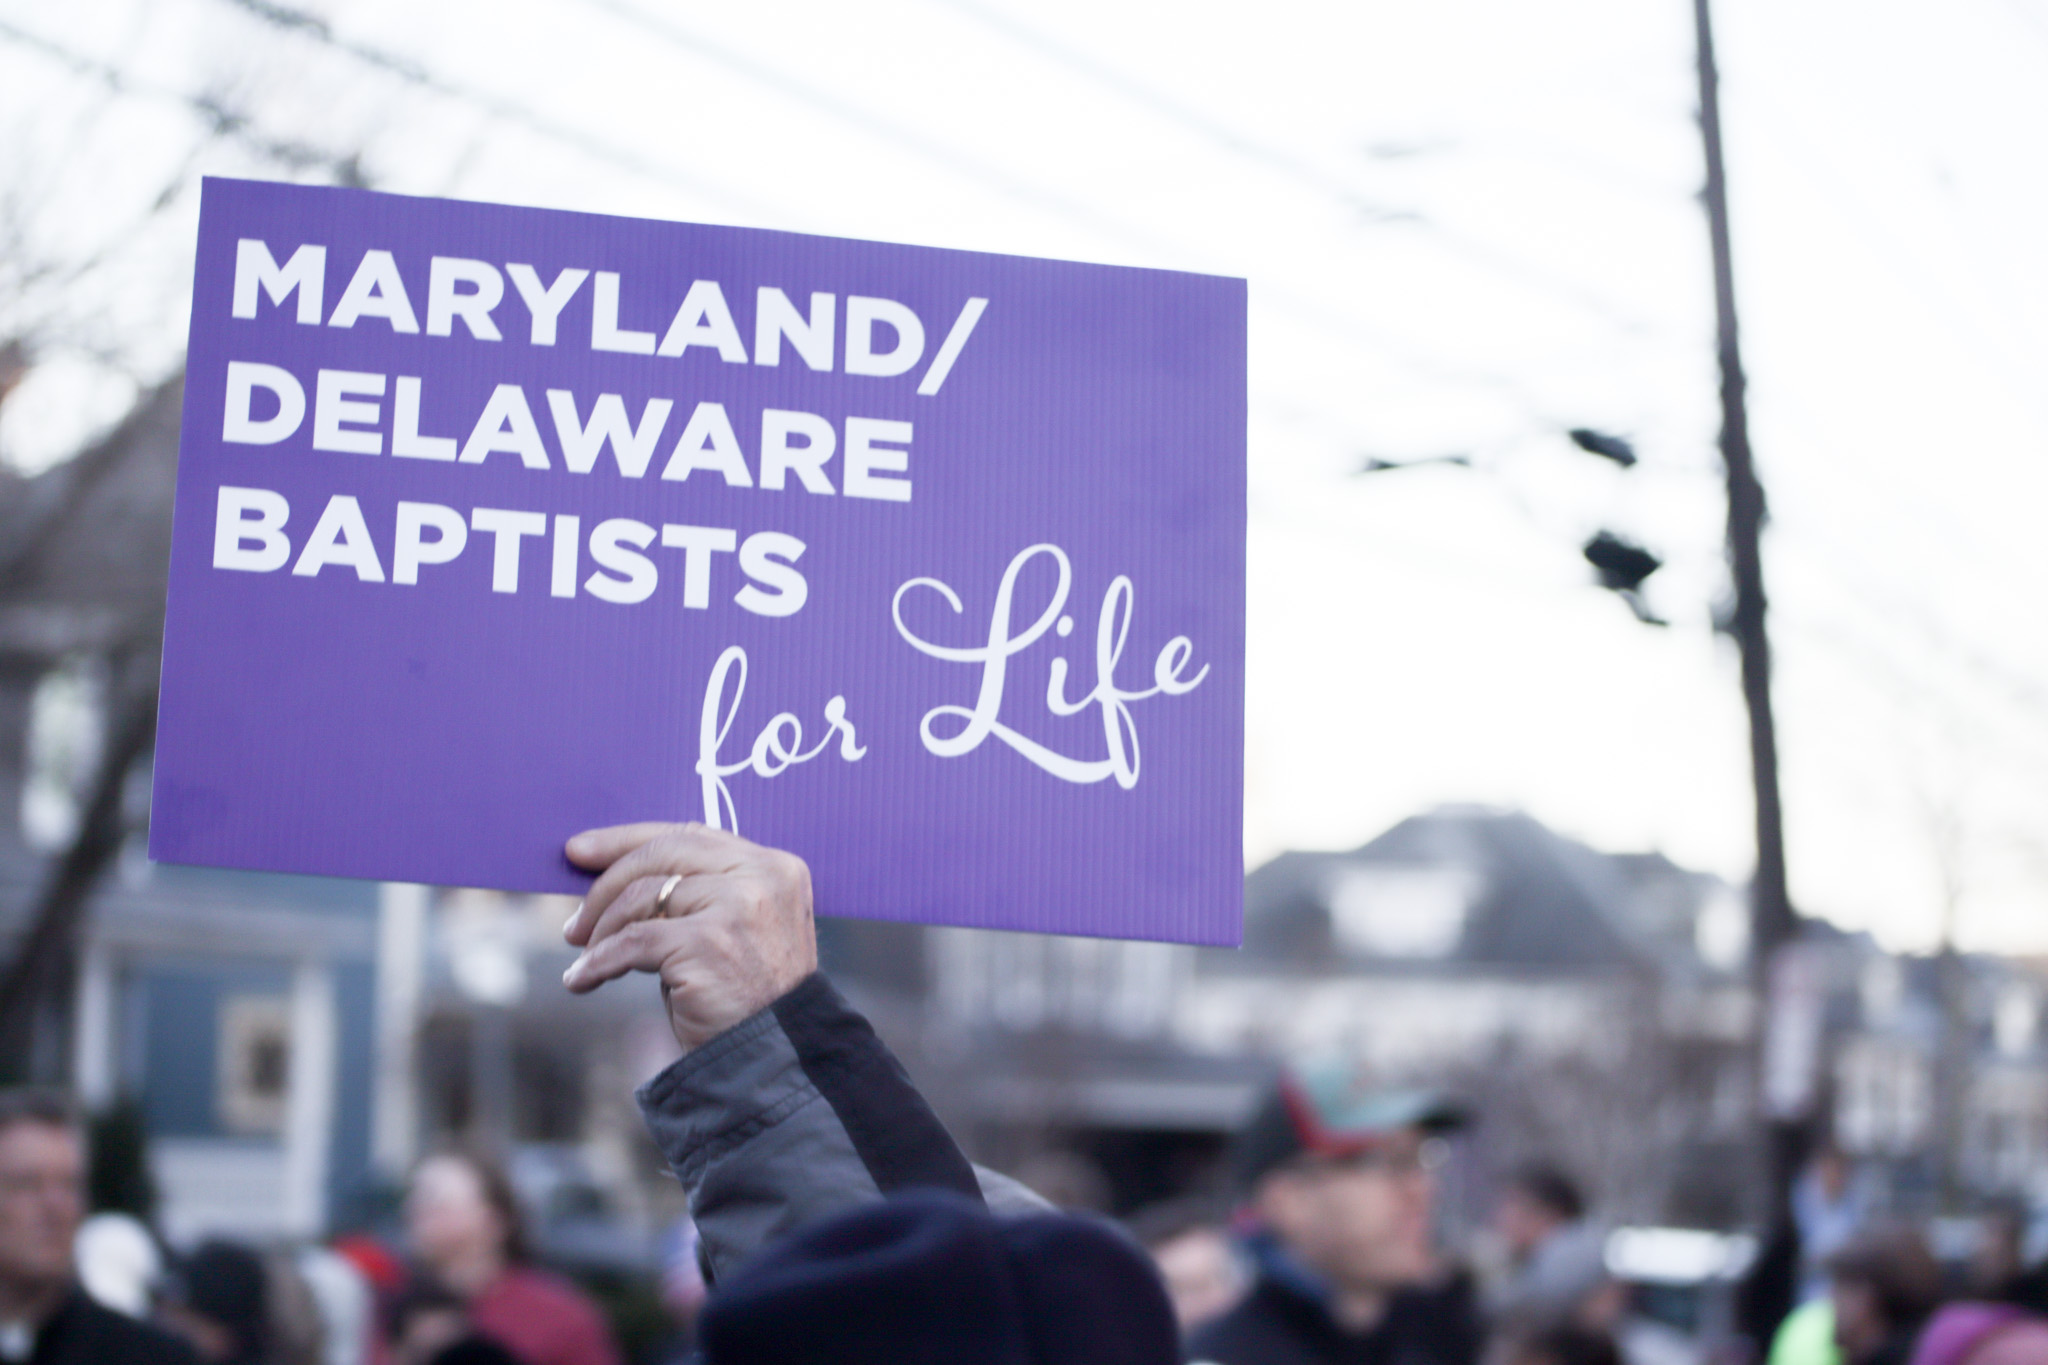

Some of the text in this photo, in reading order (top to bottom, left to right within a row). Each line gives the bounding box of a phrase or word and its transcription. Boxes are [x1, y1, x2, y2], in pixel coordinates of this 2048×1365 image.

[231, 238, 989, 397] MARYLAND/
[222, 361, 914, 503] DELAWARE
[212, 485, 809, 618] BAPTISTS
[694, 542, 1211, 836] for Life
